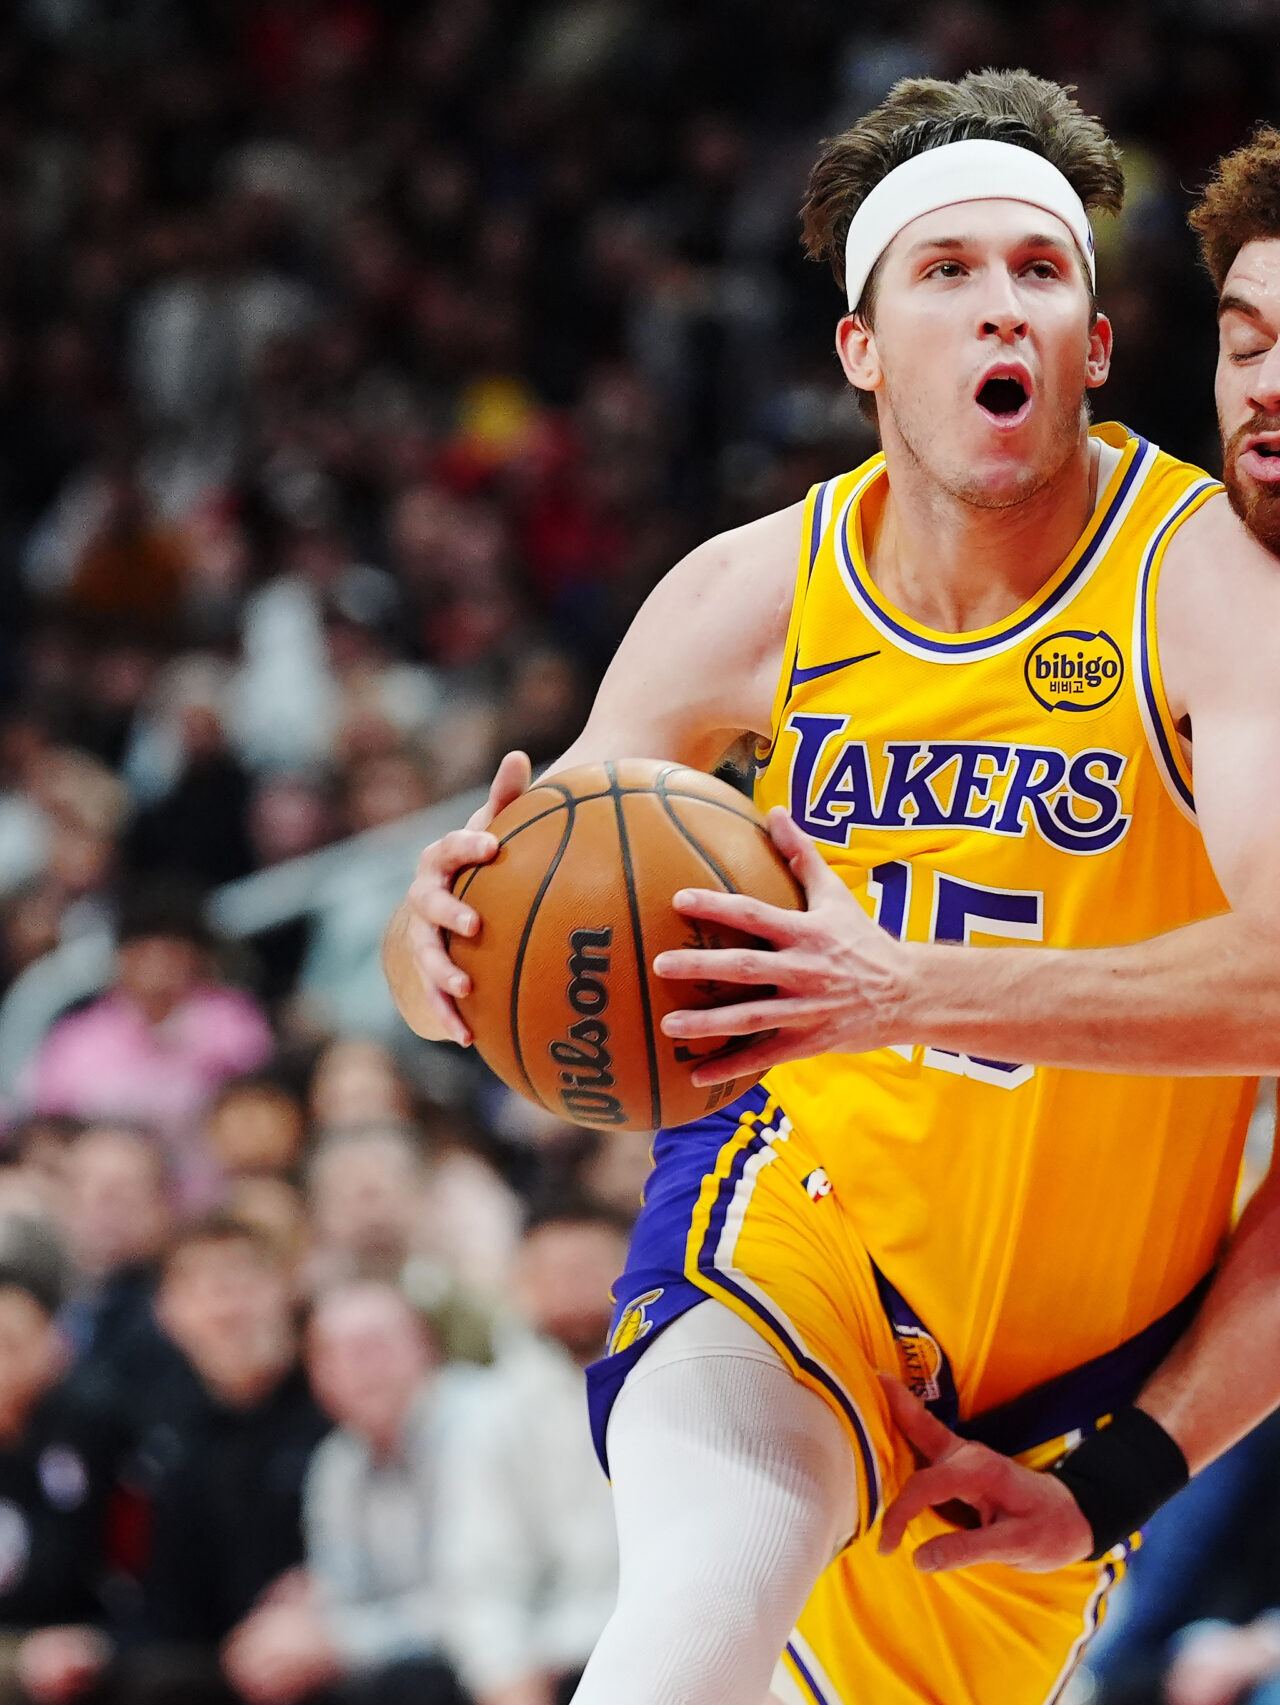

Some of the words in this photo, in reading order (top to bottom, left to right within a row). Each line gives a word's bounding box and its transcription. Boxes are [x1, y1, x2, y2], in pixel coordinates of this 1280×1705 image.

[1035, 652, 1118, 688] bibigo
[1049, 680, 1085, 694] 비비고
[785, 712, 1133, 856] LAKERS
[548, 926, 629, 1124] Wilson
